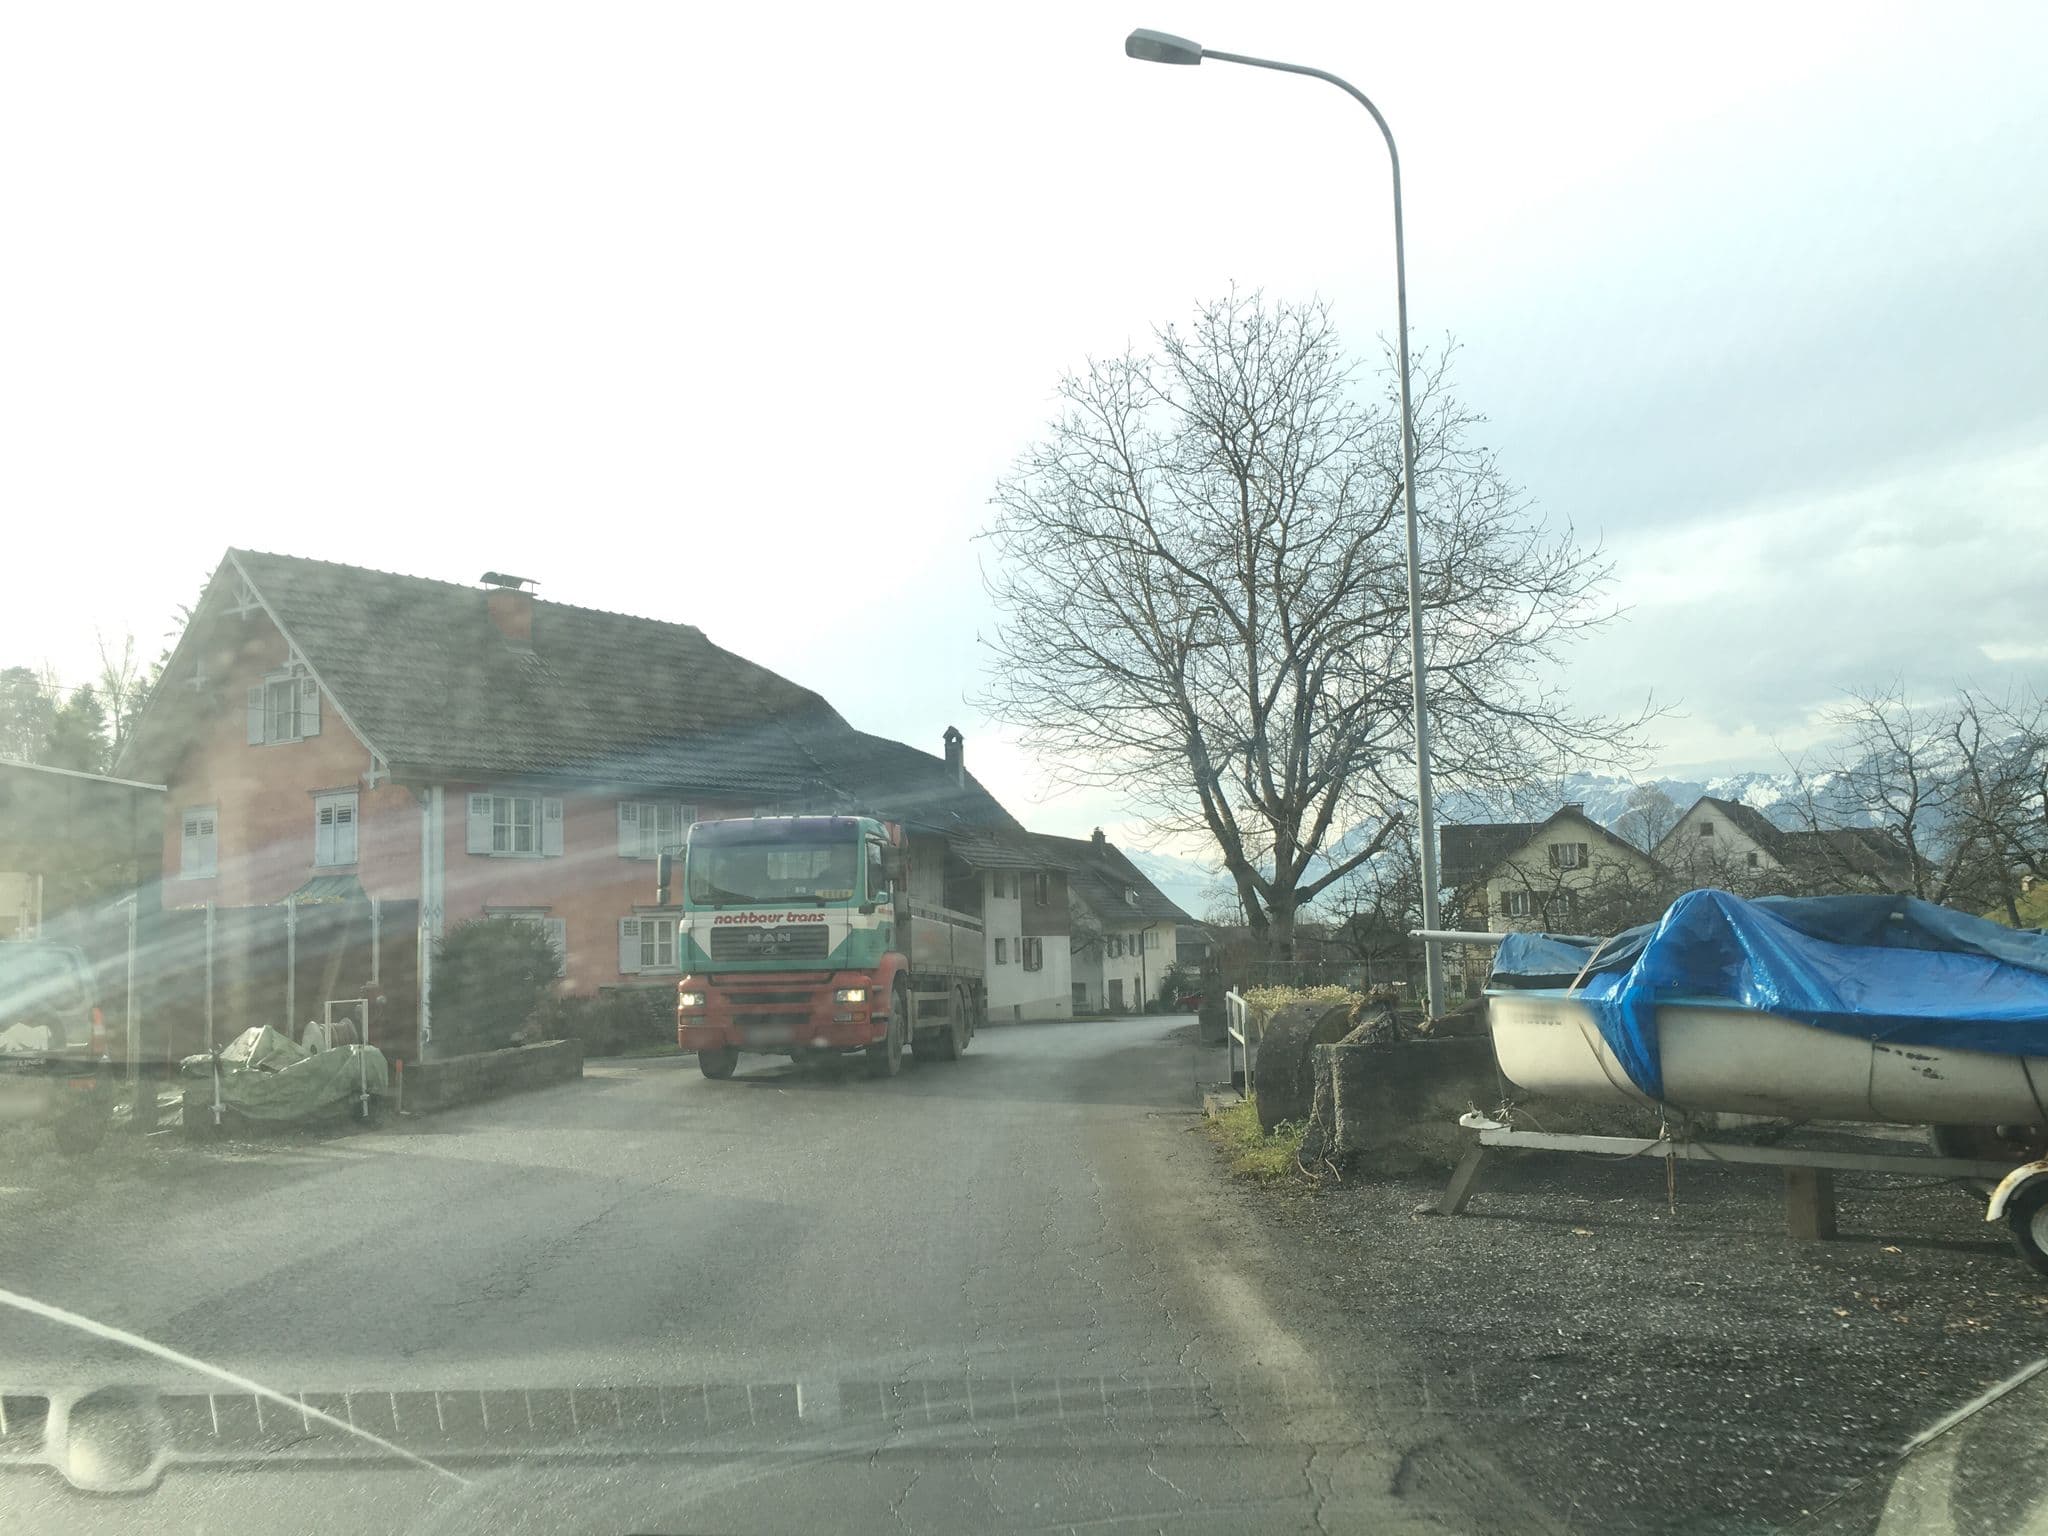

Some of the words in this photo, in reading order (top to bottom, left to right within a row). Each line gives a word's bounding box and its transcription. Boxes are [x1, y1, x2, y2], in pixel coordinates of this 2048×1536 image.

[714, 912, 784, 924] nachbaur
[786, 912, 826, 923] trans
[747, 933, 791, 942] MAN
